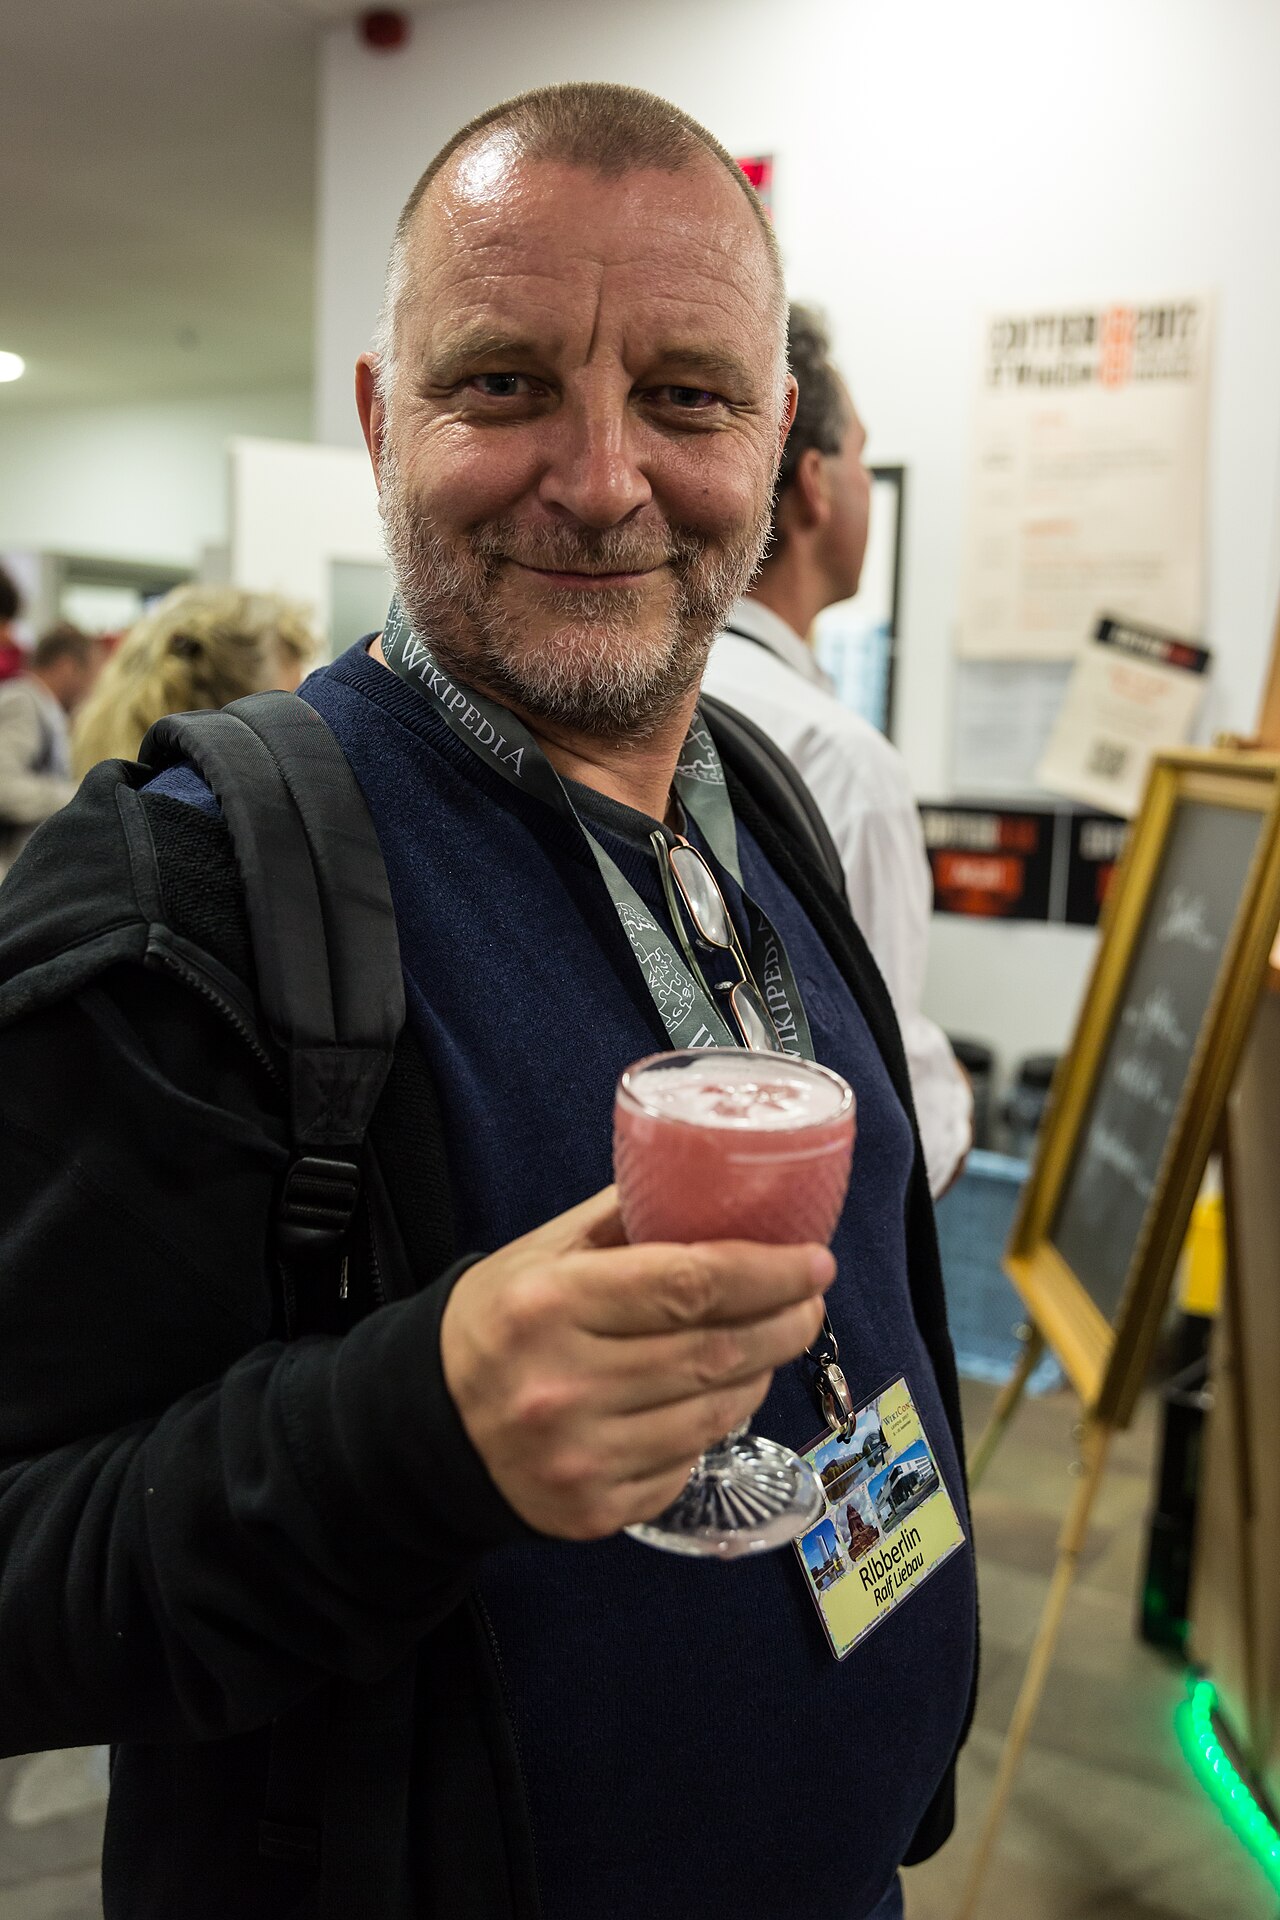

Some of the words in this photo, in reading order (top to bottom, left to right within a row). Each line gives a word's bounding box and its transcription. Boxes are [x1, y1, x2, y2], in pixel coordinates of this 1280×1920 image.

[401, 631, 525, 778] WIKIPEDIA
[757, 912, 801, 1058] IKIPEDIA
[873, 1574, 896, 1607] Ralf
[893, 1552, 925, 1593] Liebau
